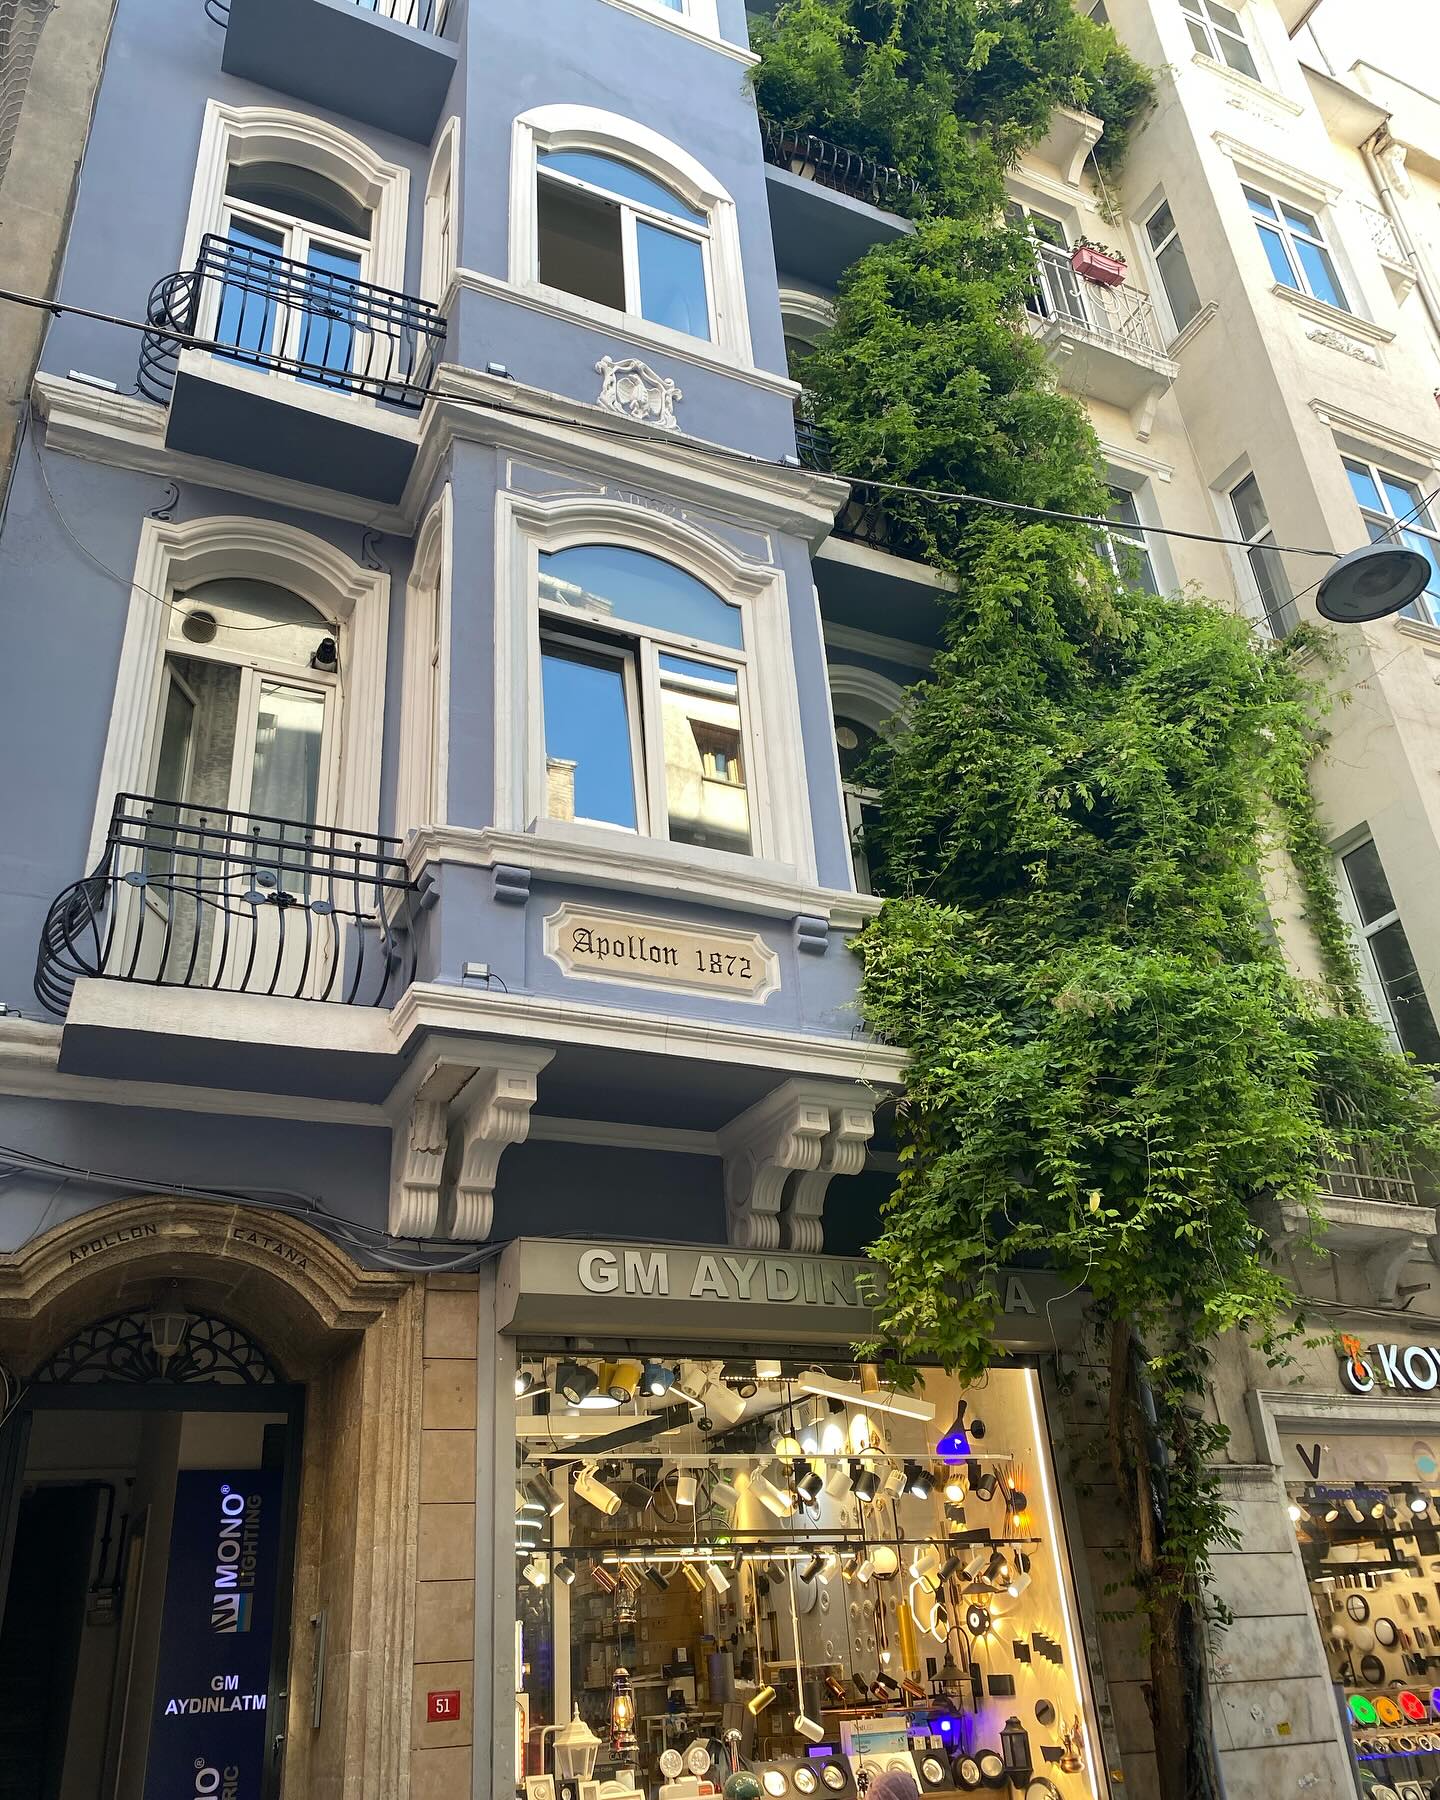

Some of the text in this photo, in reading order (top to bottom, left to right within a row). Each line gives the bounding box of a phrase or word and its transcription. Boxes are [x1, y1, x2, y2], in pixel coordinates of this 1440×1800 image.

[572, 927, 753, 979] Apollon 1872
[68, 1223, 158, 1265] APOLLON
[577, 1249, 670, 1296] GM
[210, 1675, 239, 1691] GM
[436, 1698, 450, 1713] 51
